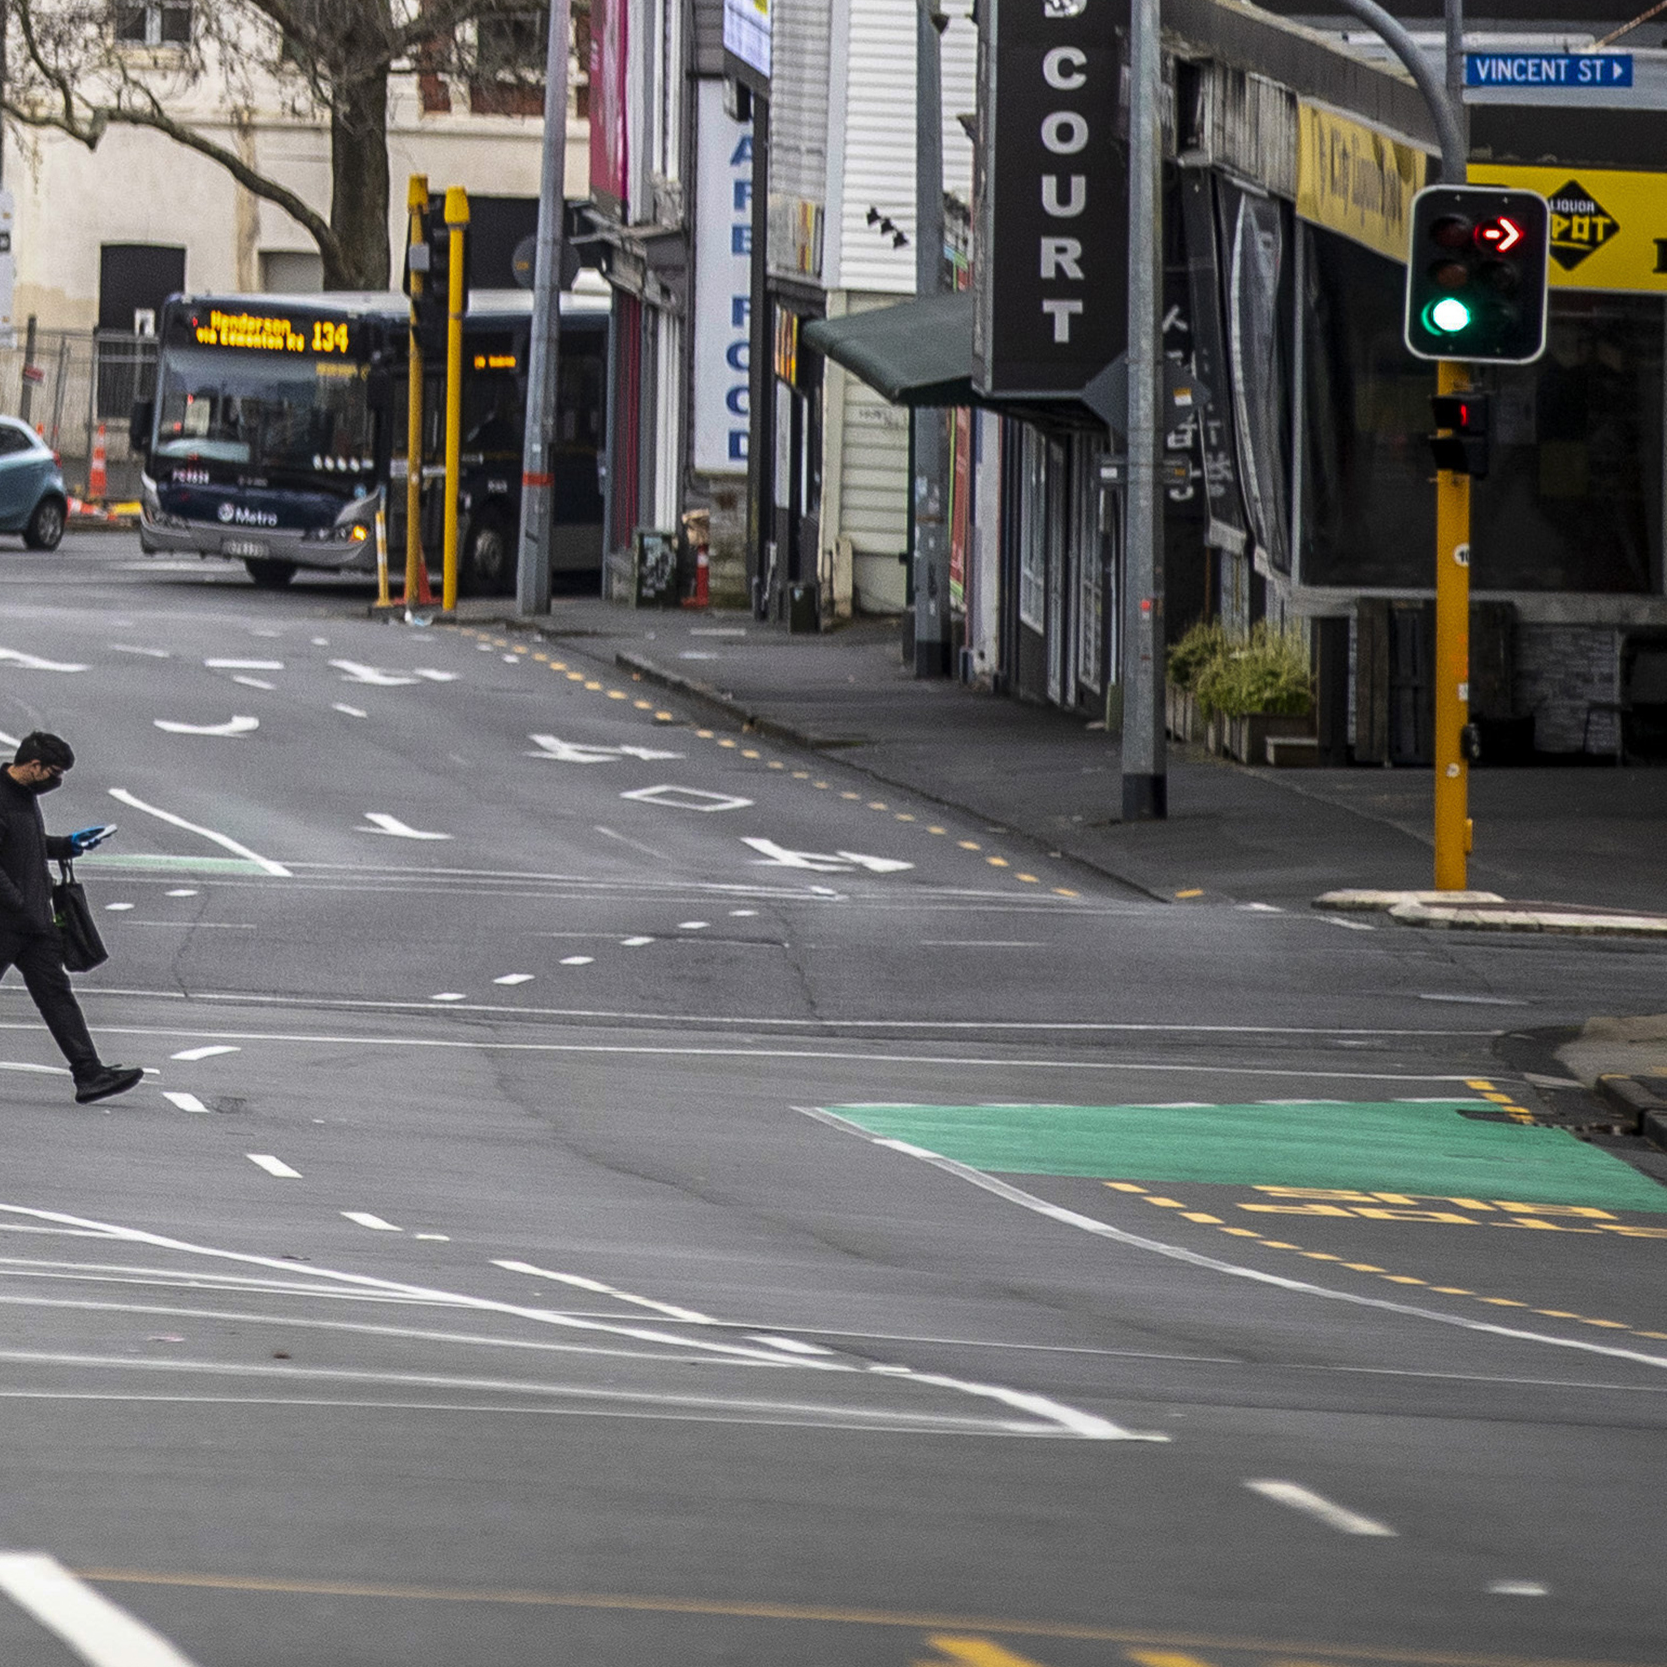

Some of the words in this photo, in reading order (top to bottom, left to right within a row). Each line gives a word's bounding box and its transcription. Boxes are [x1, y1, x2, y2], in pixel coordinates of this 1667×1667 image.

[1476, 58, 1569, 82] VINCENT
[1577, 59, 1605, 82] ST
[1040, 44, 1089, 344] COURT
[311, 320, 349, 353] 134
[235, 506, 278, 527] Metro
